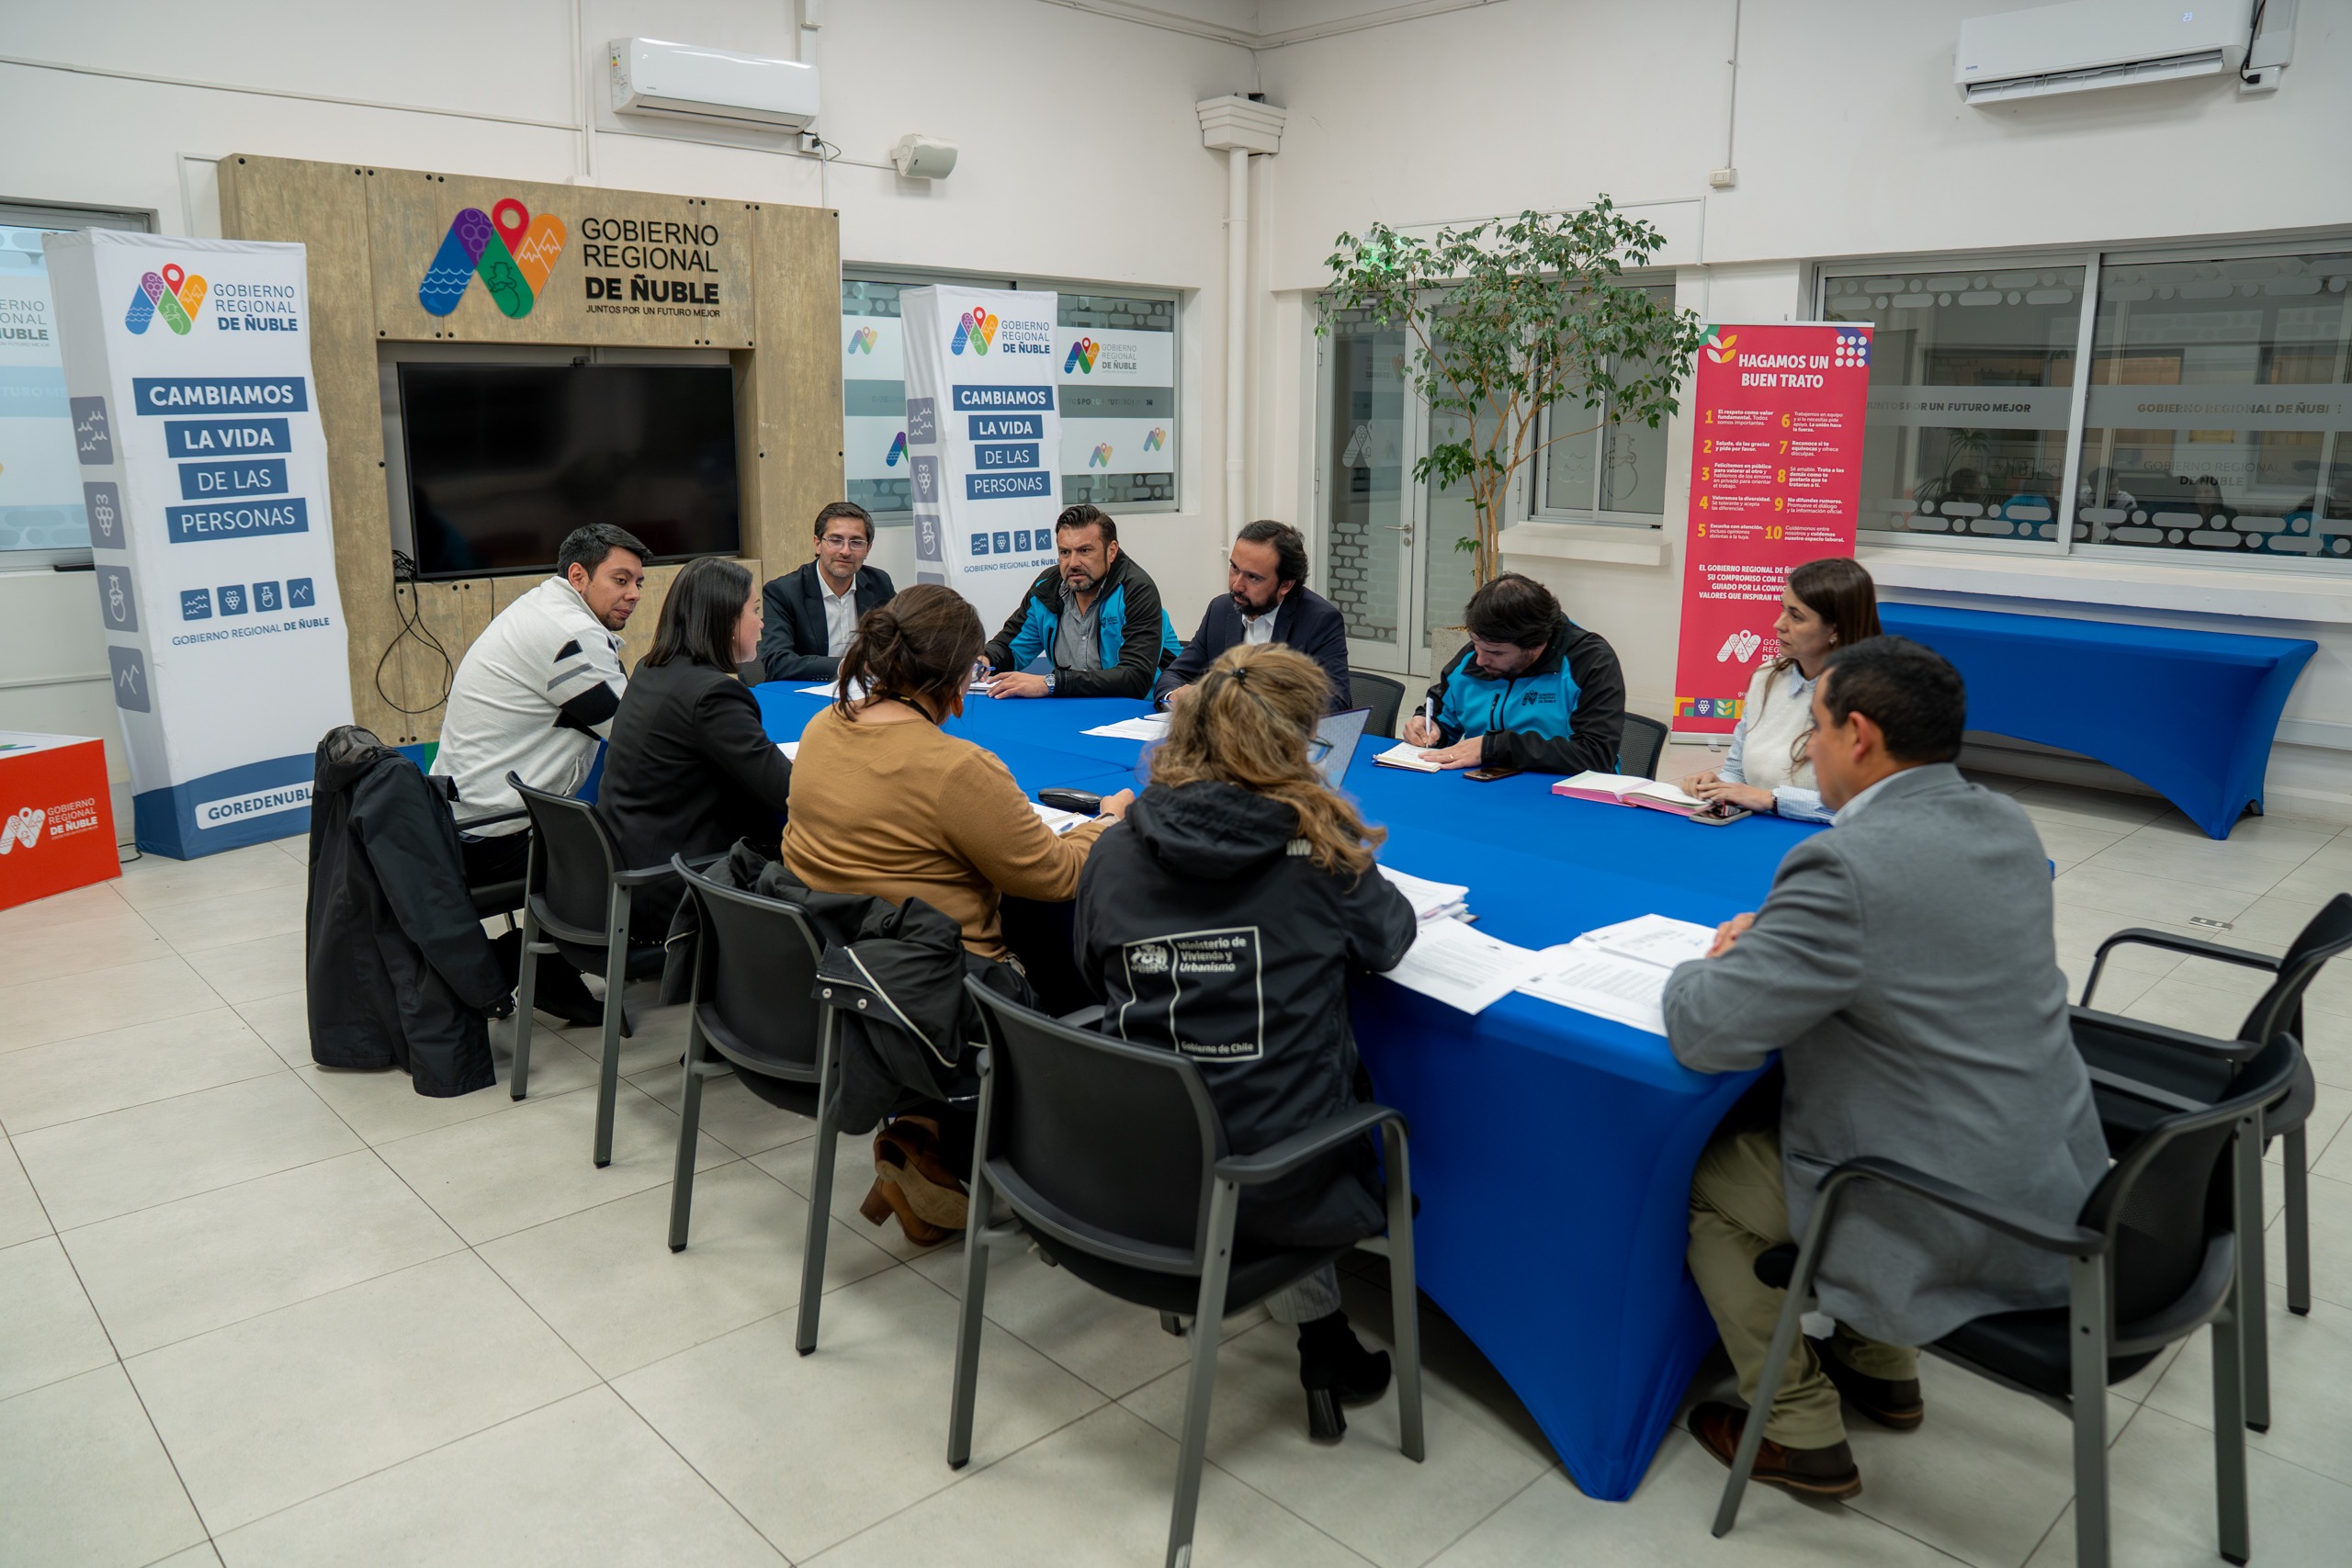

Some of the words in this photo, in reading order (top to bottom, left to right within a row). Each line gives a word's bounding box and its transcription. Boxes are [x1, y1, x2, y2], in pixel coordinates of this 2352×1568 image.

[582, 218, 718, 246] GOBIERNO
[583, 244, 718, 272] REGIONAL
[214, 284, 294, 298] GOBIERNO
[585, 276, 623, 300] DE
[630, 274, 719, 305] ÑUBLE
[216, 299, 296, 313] REGIONAL
[586, 305, 620, 313] JUNTOS
[658, 308, 691, 316] FUTURO
[218, 317, 241, 331] DE
[245, 314, 298, 331] ÑUBLE
[1001, 321, 1049, 331] GOBIERNO
[1002, 332, 1049, 341] REGIONAL
[1003, 344, 1016, 353] DE
[1019, 342, 1050, 354] ÑUBLE
[1102, 344, 1136, 352] GOBIERNO
[1114, 360, 1136, 369] ÑUBLE
[1739, 354, 1806, 368] HAGAMOS
[1810, 355, 1829, 368] UN
[1741, 373, 1777, 387] BUEN
[1780, 374, 1823, 388] TRATO
[149, 385, 294, 406] CAMBIAMOS
[961, 390, 1046, 404] CAMBIAMOS
[1929, 402, 1945, 411] UN
[1948, 403, 1990, 412] FUTURO
[1993, 403, 2030, 412] MEJOR
[2138, 403, 2202, 413] GOBIERNO
[2205, 404, 2272, 413] REGIONAL
[2275, 404, 2292, 413] DE
[1705, 410, 1713, 423] 1
[1781, 414, 1790, 427] 6
[979, 422, 997, 434] LA
[999, 421, 1033, 434] VIDA
[185, 430, 215, 449] LA
[217, 428, 275, 448] VIDA
[1703, 440, 1712, 453] 2
[1780, 441, 1788, 454] 7
[985, 451, 1003, 464] DE
[1007, 450, 1029, 463] LAS
[2144, 461, 2211, 471] GOBIERNO
[198, 472, 228, 491] DE
[234, 469, 272, 489] LAS
[1702, 468, 1710, 480] 3
[1778, 469, 1786, 483] 8
[975, 477, 1043, 493] PERSONAS
[1700, 496, 1708, 509] 4
[1775, 498, 1783, 511] 9
[181, 507, 295, 533] PERSONAS
[1698, 524, 1705, 537] 5
[1765, 525, 1781, 539] 10
[965, 564, 998, 572] GOBIERNO
[173, 630, 229, 645] GOBIERNO
[232, 625, 281, 637] REGIONAL
[284, 622, 296, 631] DE
[299, 617, 330, 629] ÑUBLE
[47, 797, 95, 816] GOBIERNO
[49, 807, 96, 825] REGIONAL
[50, 825, 64, 835] DE
[65, 816, 98, 831] ÑUBLE
[1177, 938, 1229, 950] Ministerio
[1232, 937, 1246, 946] de
[1182, 952, 1223, 961] Vivienda
[1227, 951, 1232, 962] y
[1180, 963, 1236, 972] Urbanismo
[1182, 1042, 1216, 1053] Gobierno
[1218, 1043, 1229, 1054] de
[1231, 1043, 1253, 1053] Chile
